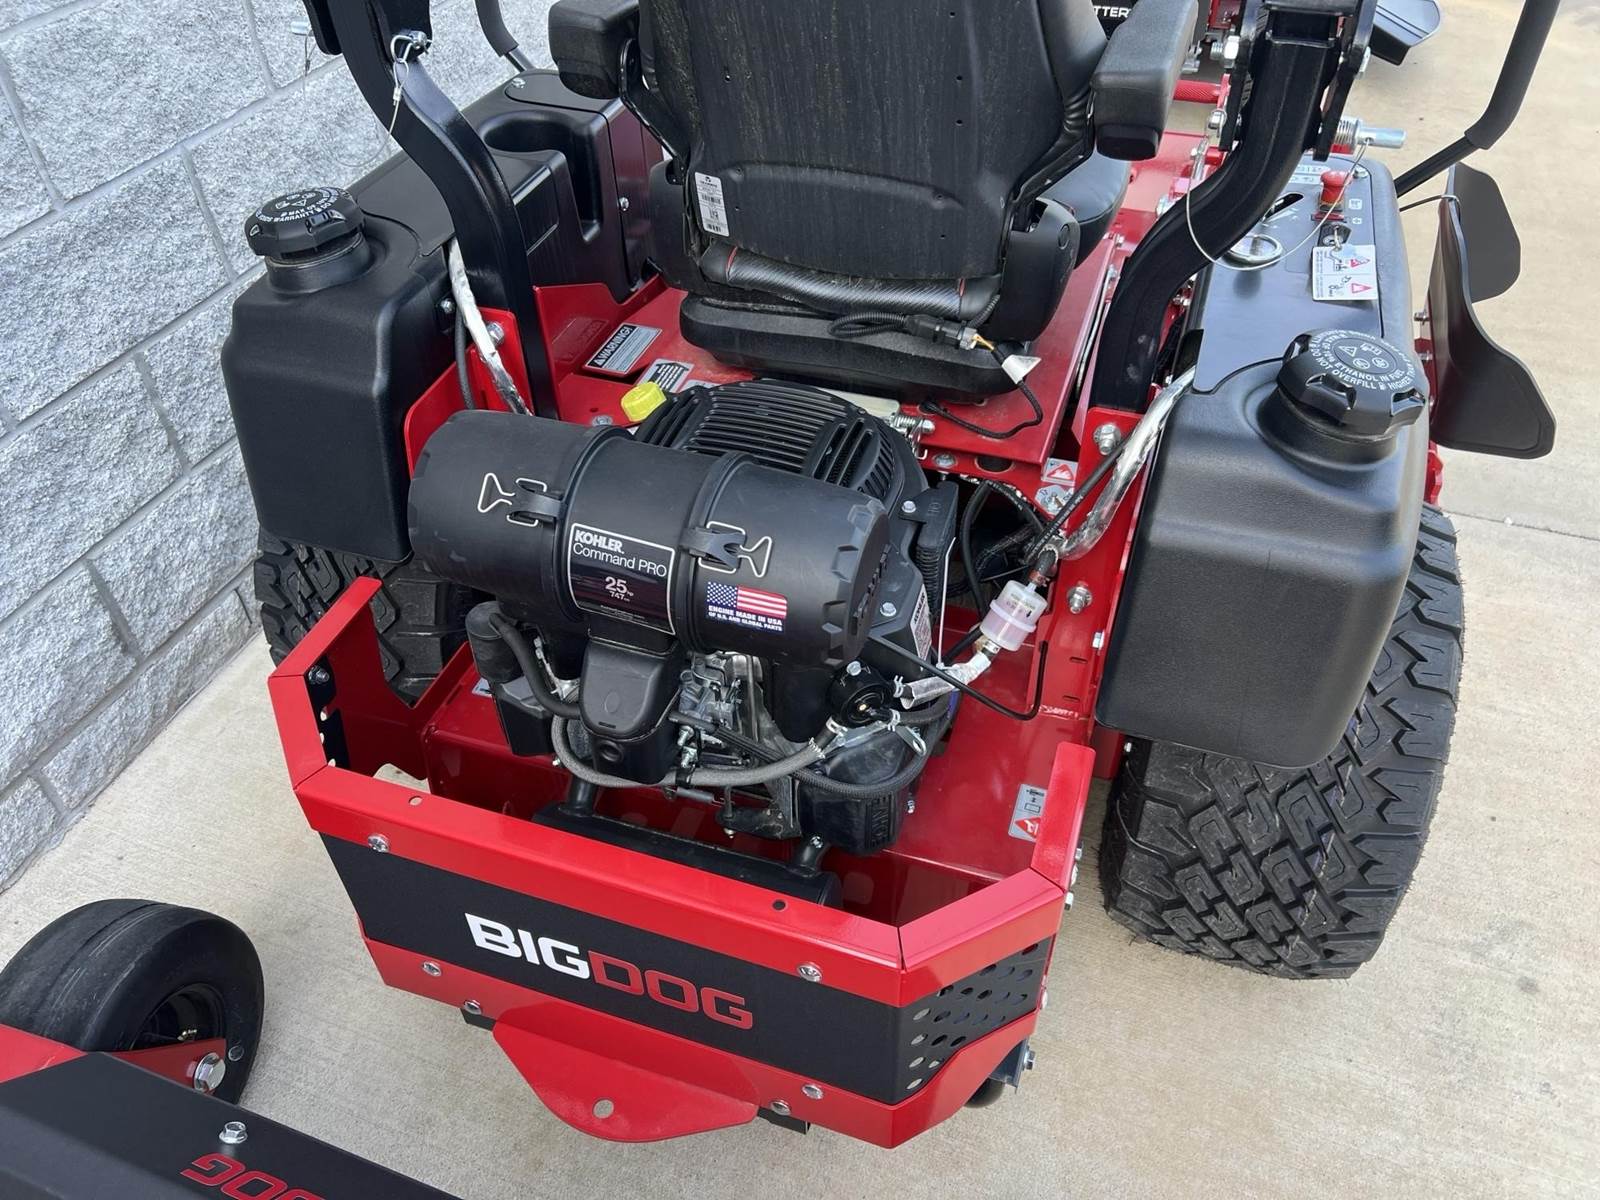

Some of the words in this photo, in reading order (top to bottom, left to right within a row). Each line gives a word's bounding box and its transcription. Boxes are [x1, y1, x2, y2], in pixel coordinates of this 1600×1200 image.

[1315, 357, 1334, 369] NOT
[1332, 369, 1376, 389] OVERFILL
[1335, 362, 1379, 382] ETHANOL
[573, 542, 635, 569] Command
[638, 560, 667, 578] PRO
[605, 576, 628, 594] 25
[609, 591, 625, 600] 747
[708, 605, 735, 617] ENGINE
[735, 611, 757, 621] MADE
[767, 617, 783, 626] USA
[741, 620, 763, 629] GLOBAL
[763, 623, 783, 632] PARTS
